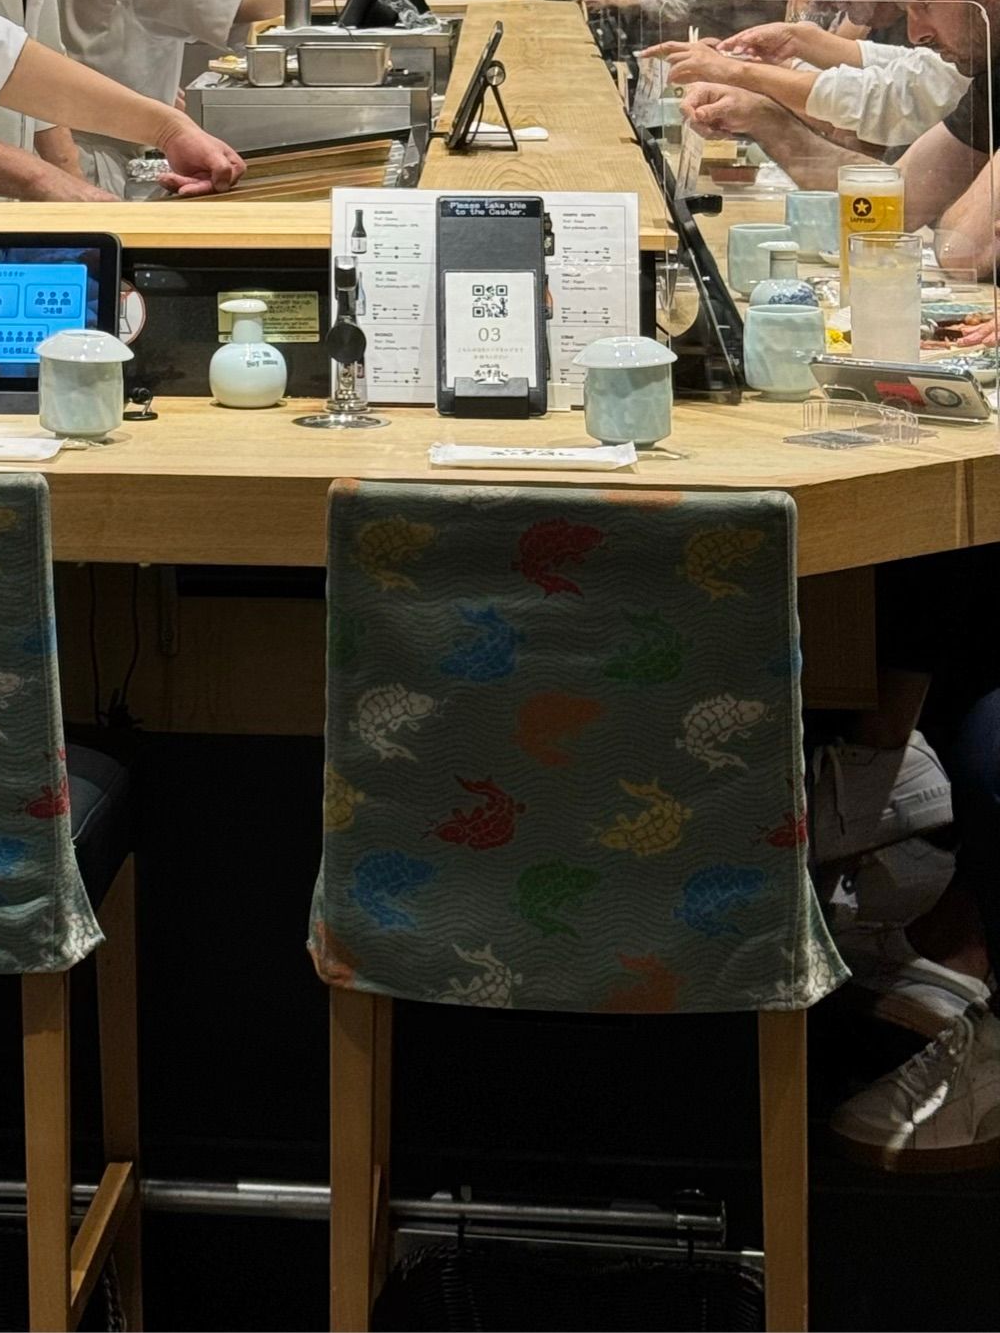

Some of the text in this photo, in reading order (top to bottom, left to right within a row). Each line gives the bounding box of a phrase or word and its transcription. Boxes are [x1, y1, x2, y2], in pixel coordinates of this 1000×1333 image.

[450, 202, 527, 210] Please take this
[478, 327, 501, 342] 03
